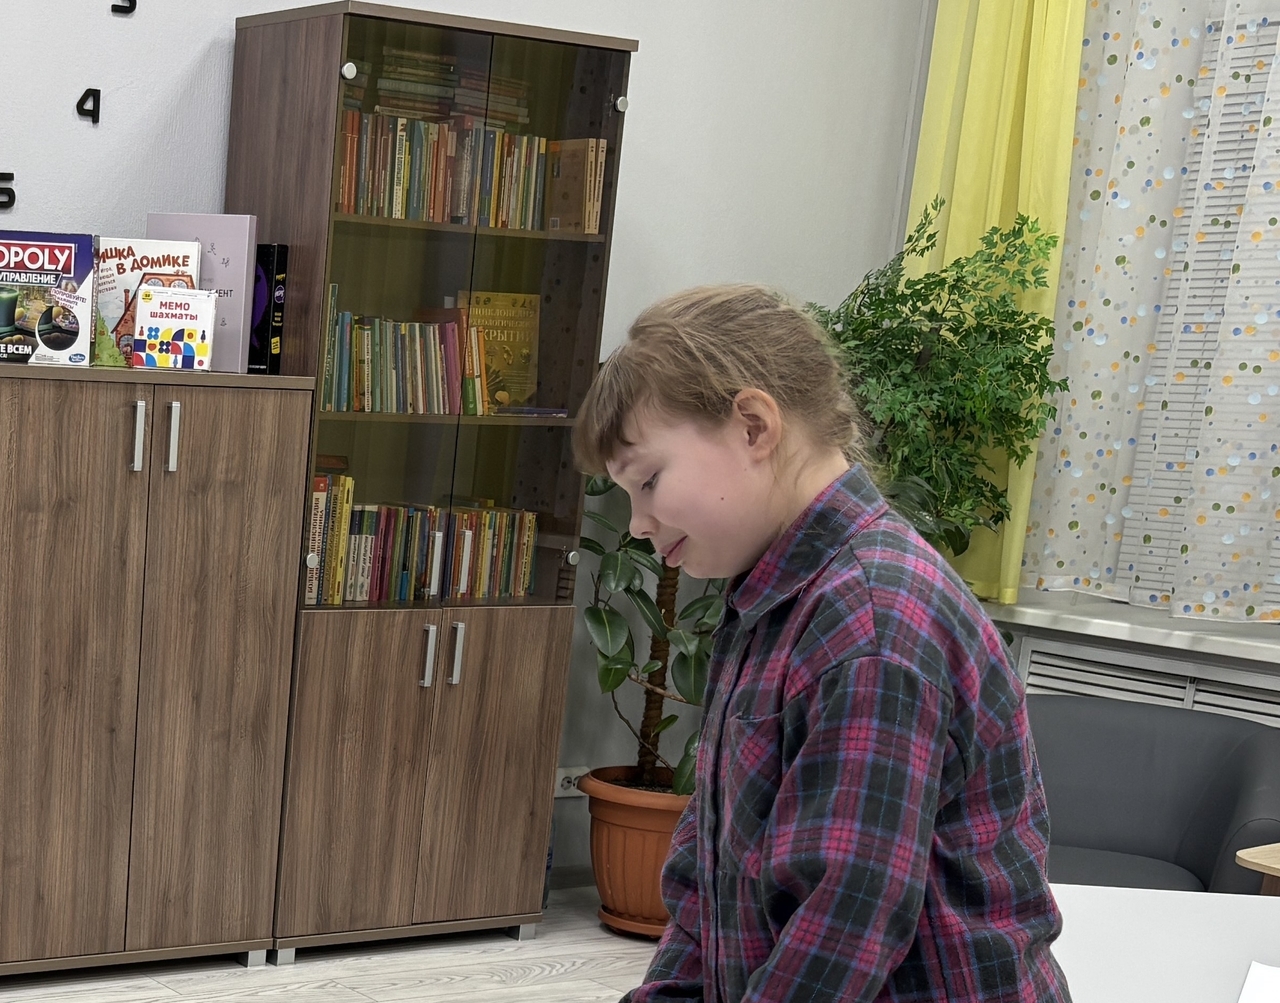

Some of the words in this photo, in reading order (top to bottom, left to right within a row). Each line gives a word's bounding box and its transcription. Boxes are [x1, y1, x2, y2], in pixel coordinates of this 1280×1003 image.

[76, 88, 101, 124] 4
[130, 254, 190, 272] ДОМИКЕ
[160, 301, 190, 311] МЕМО
[150, 311, 198, 321] шахматы
[7, 344, 32, 355] ВСЕМ
